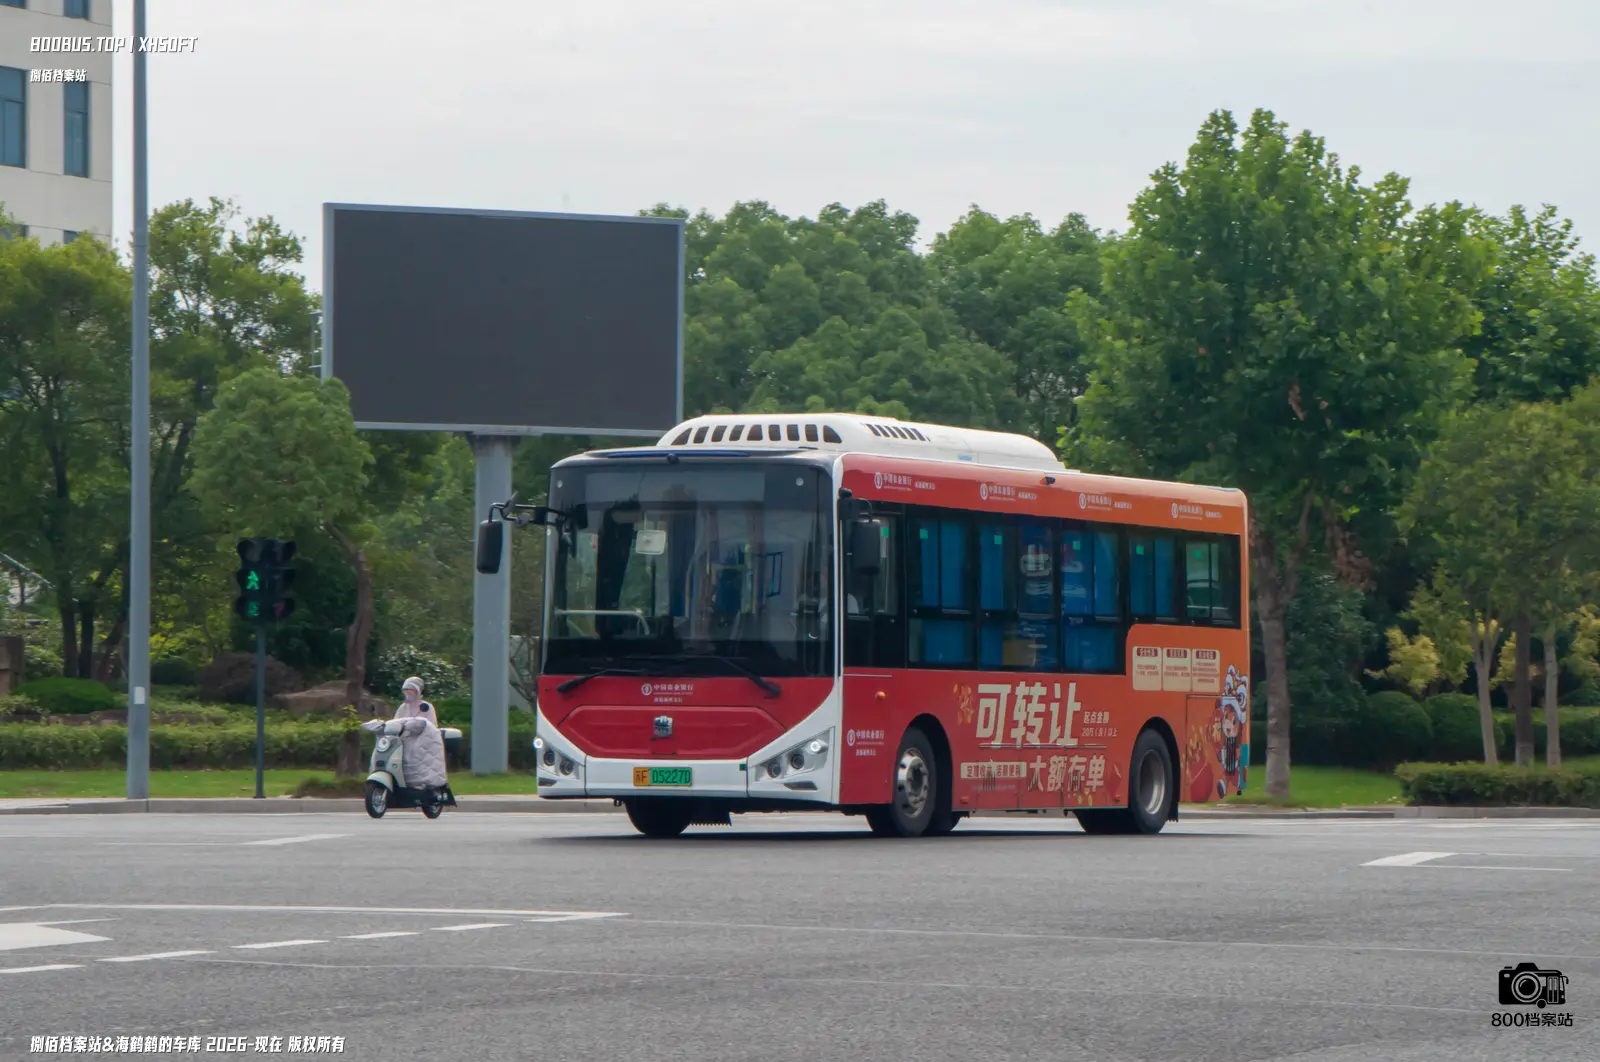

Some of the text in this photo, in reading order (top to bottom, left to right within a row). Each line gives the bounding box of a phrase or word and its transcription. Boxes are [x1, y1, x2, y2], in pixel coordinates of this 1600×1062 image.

[975, 681, 1082, 749] 可转让
[1027, 754, 1106, 793] 大额存单
